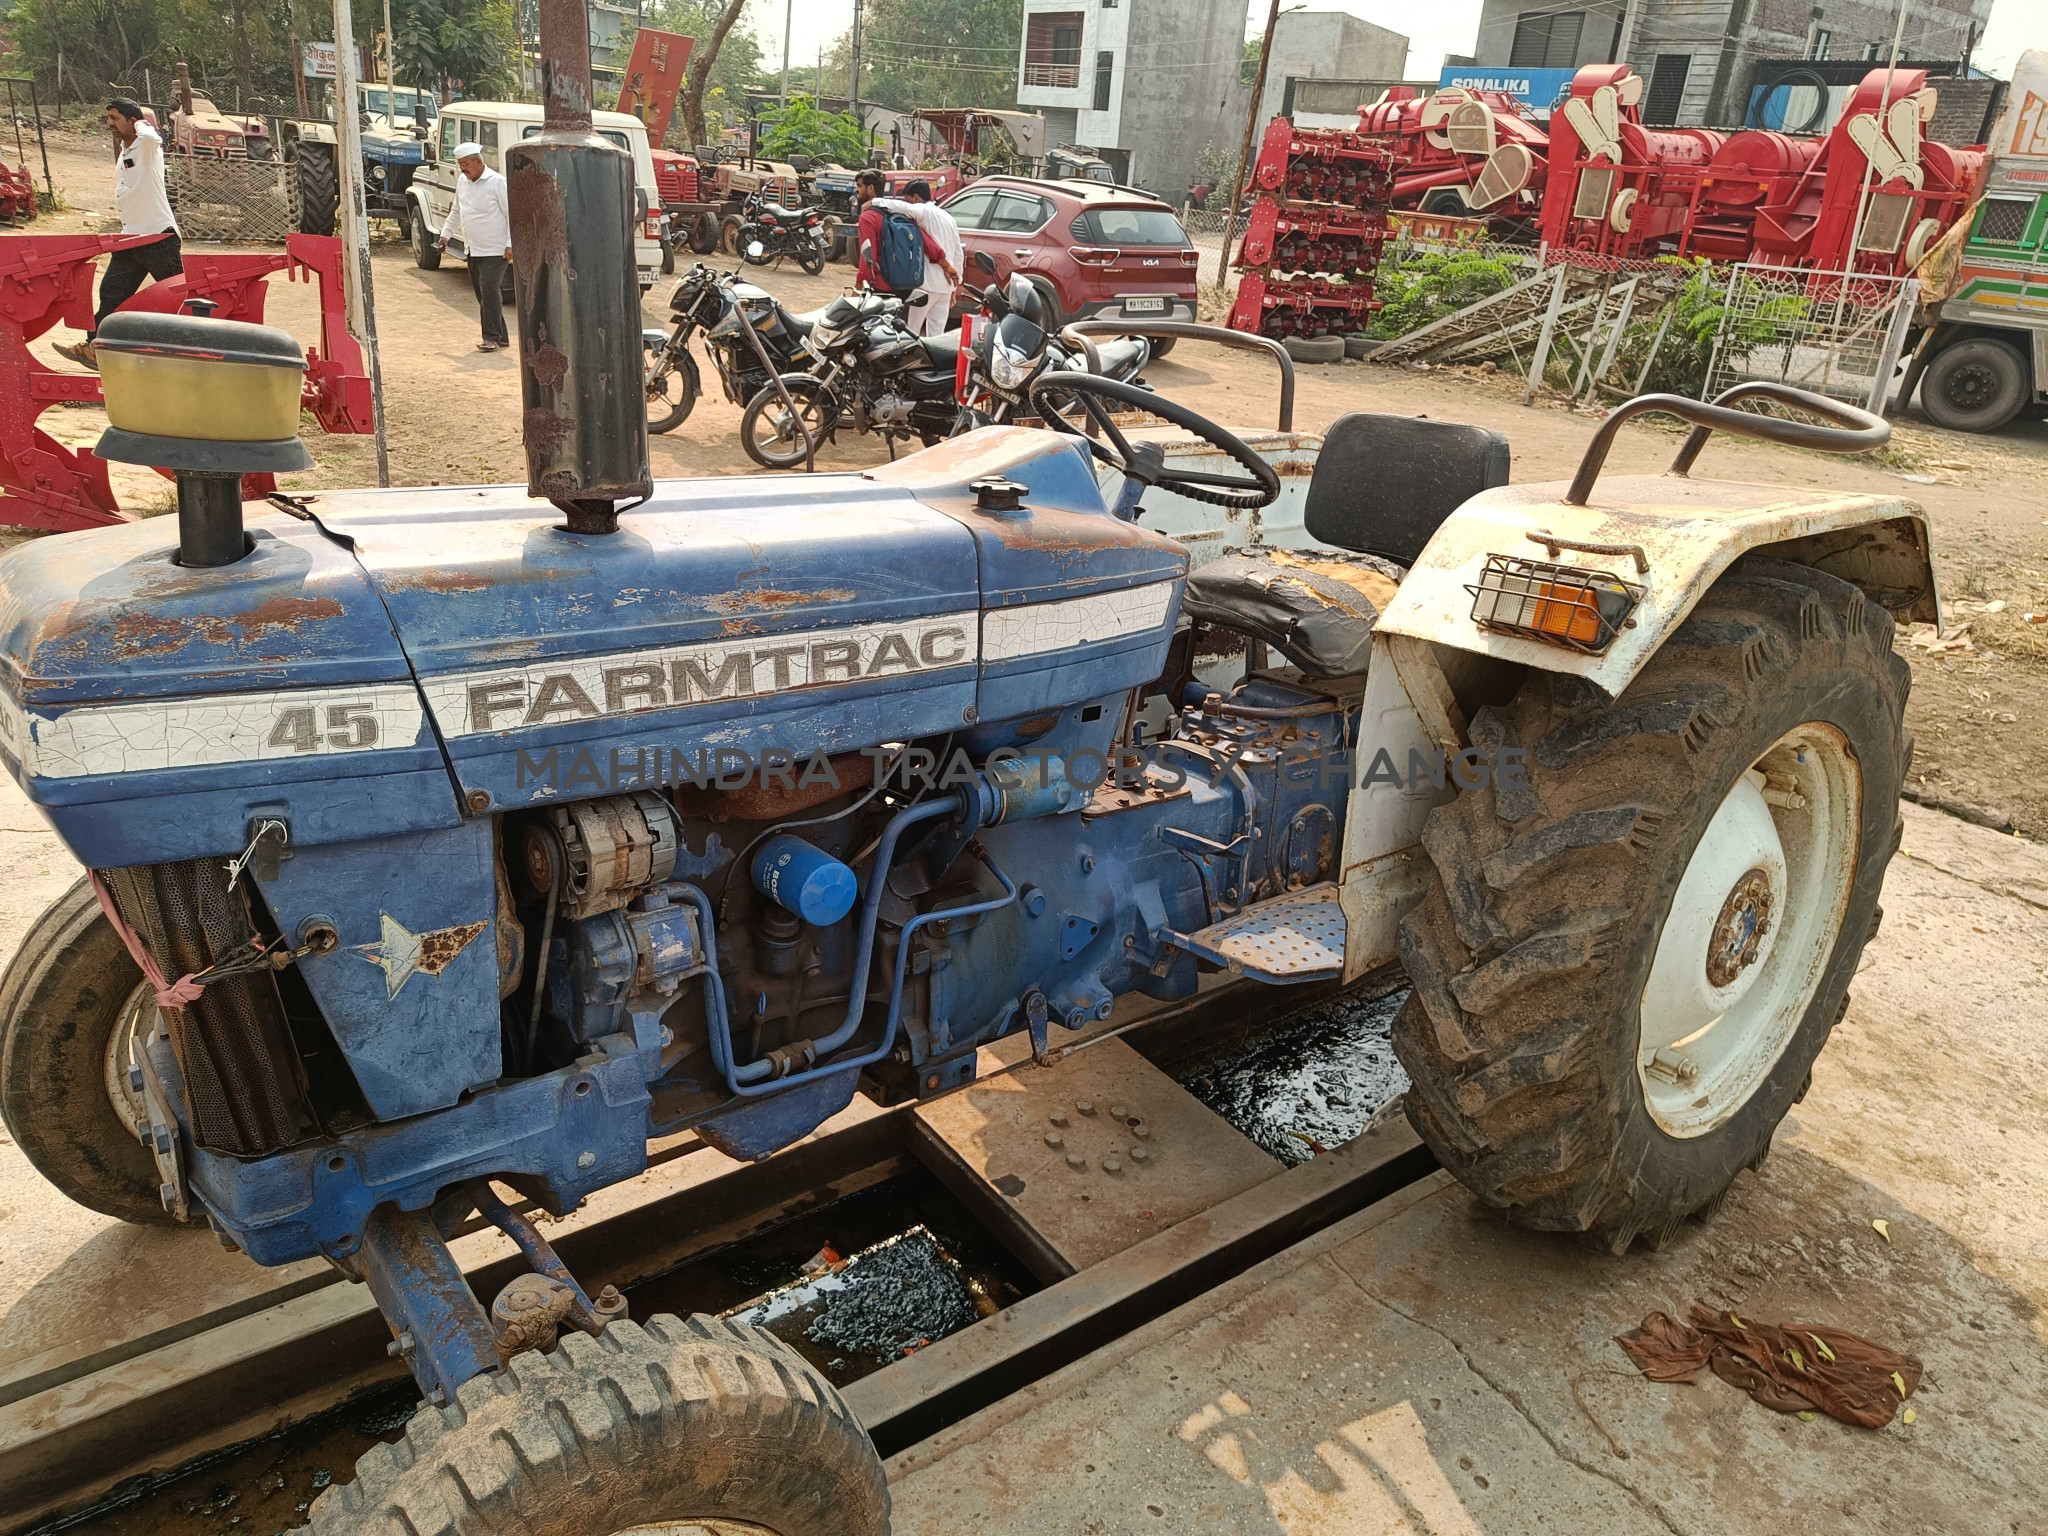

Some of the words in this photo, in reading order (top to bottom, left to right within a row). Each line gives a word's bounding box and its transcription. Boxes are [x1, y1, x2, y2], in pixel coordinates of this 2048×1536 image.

[1451, 78, 1530, 95] SONALIKA
[466, 628, 967, 732] FARMTRAC
[268, 703, 379, 753] 45
